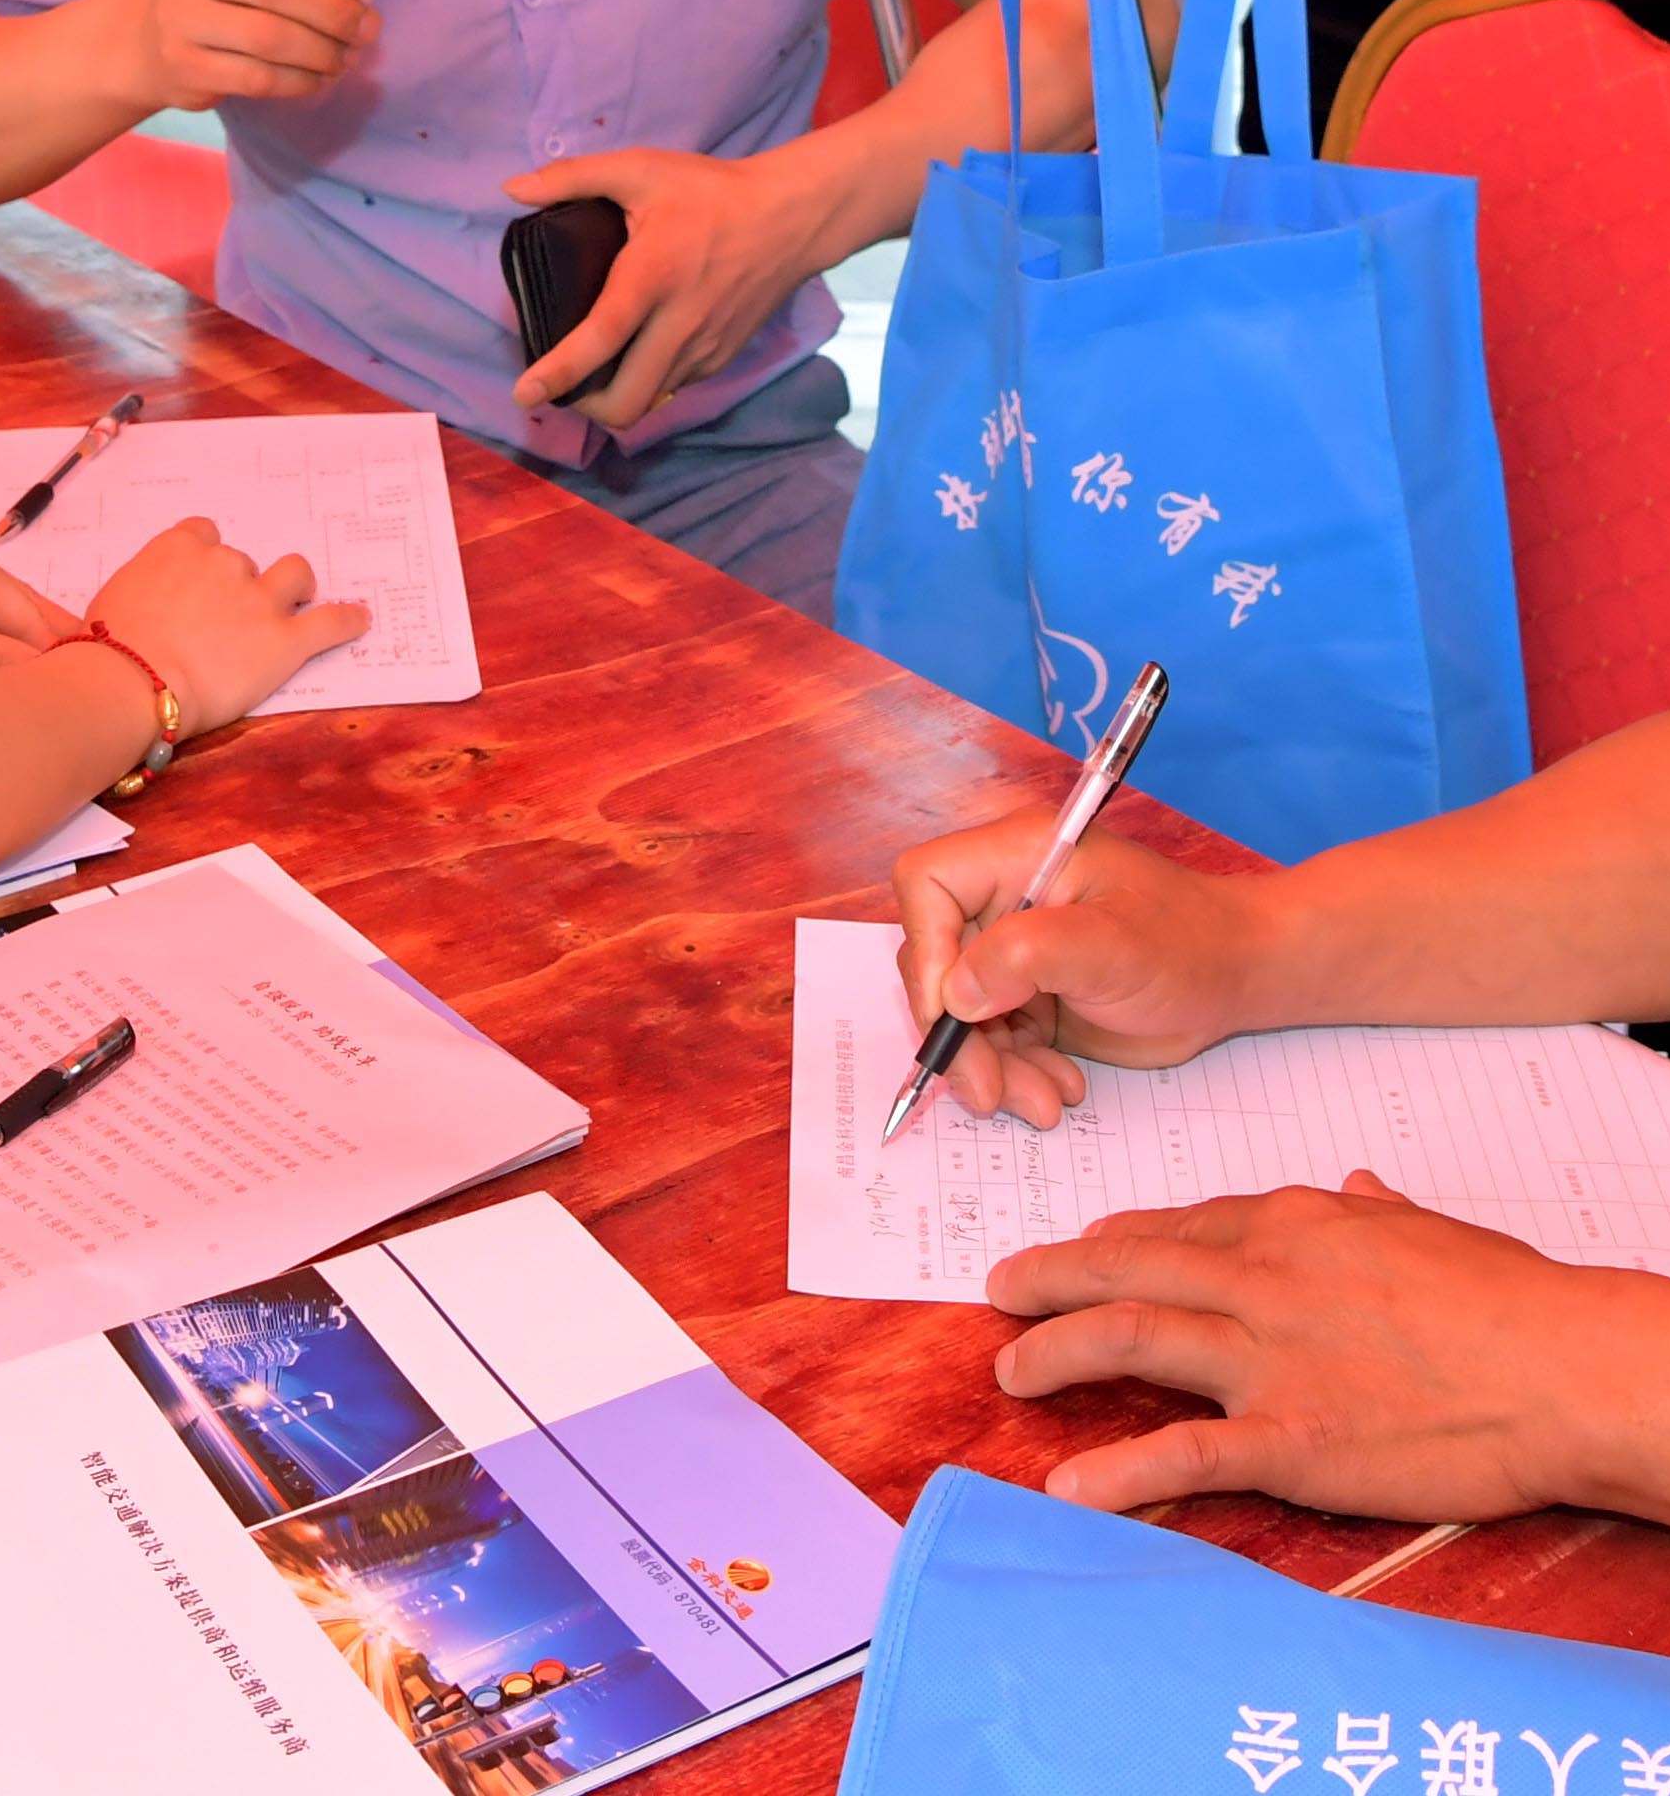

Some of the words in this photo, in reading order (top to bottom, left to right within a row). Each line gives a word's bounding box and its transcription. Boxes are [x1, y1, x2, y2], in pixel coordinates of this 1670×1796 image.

[835, 1018, 857, 1180] 南昌金科交通科技股份有限公司
[80, 1450, 311, 1756] 智能交通解决方案提供商和运维服务商
[620, 1538, 721, 1636] 股票代码:870481
